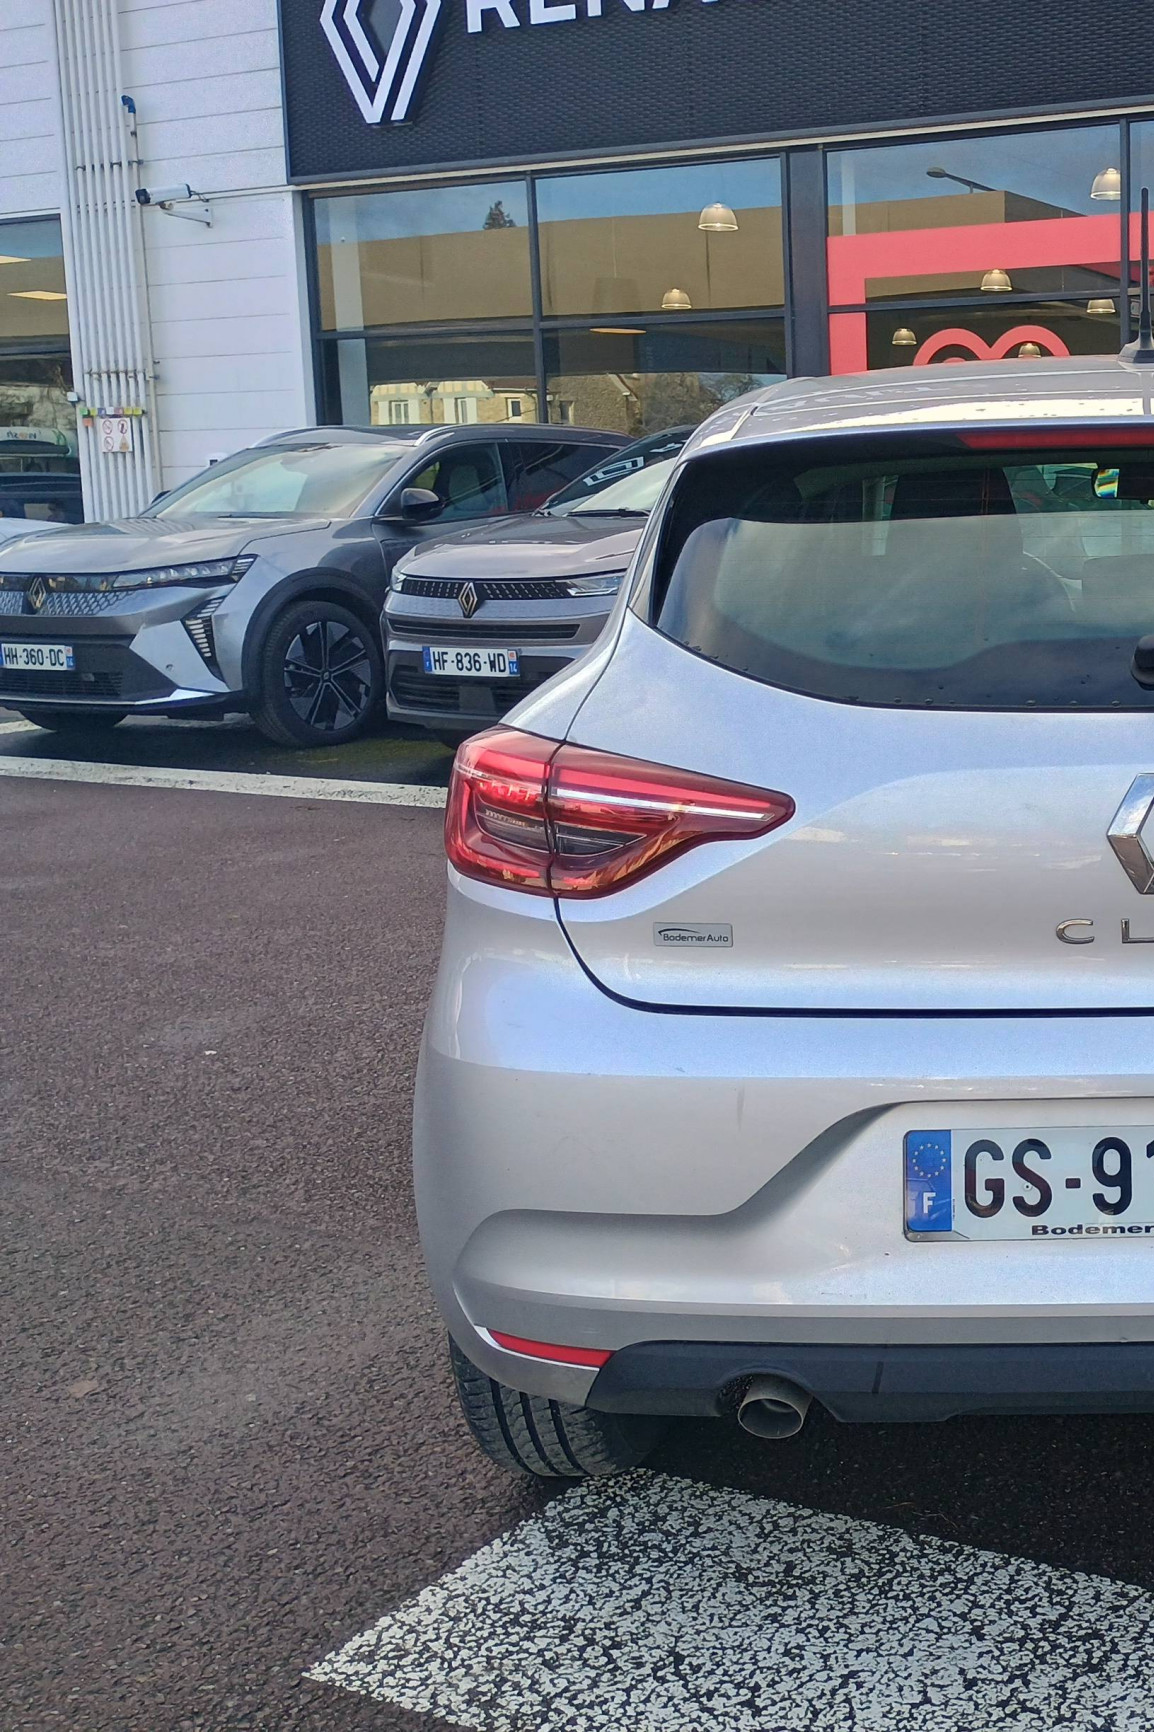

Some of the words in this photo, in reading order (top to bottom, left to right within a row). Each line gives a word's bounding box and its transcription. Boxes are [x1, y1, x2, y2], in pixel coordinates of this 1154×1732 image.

[4, 647, 64, 666] HH-360-DC
[432, 650, 507, 673] HF-836-WD
[663, 933, 729, 942] BodemerAuto
[922, 1191, 936, 1215] F
